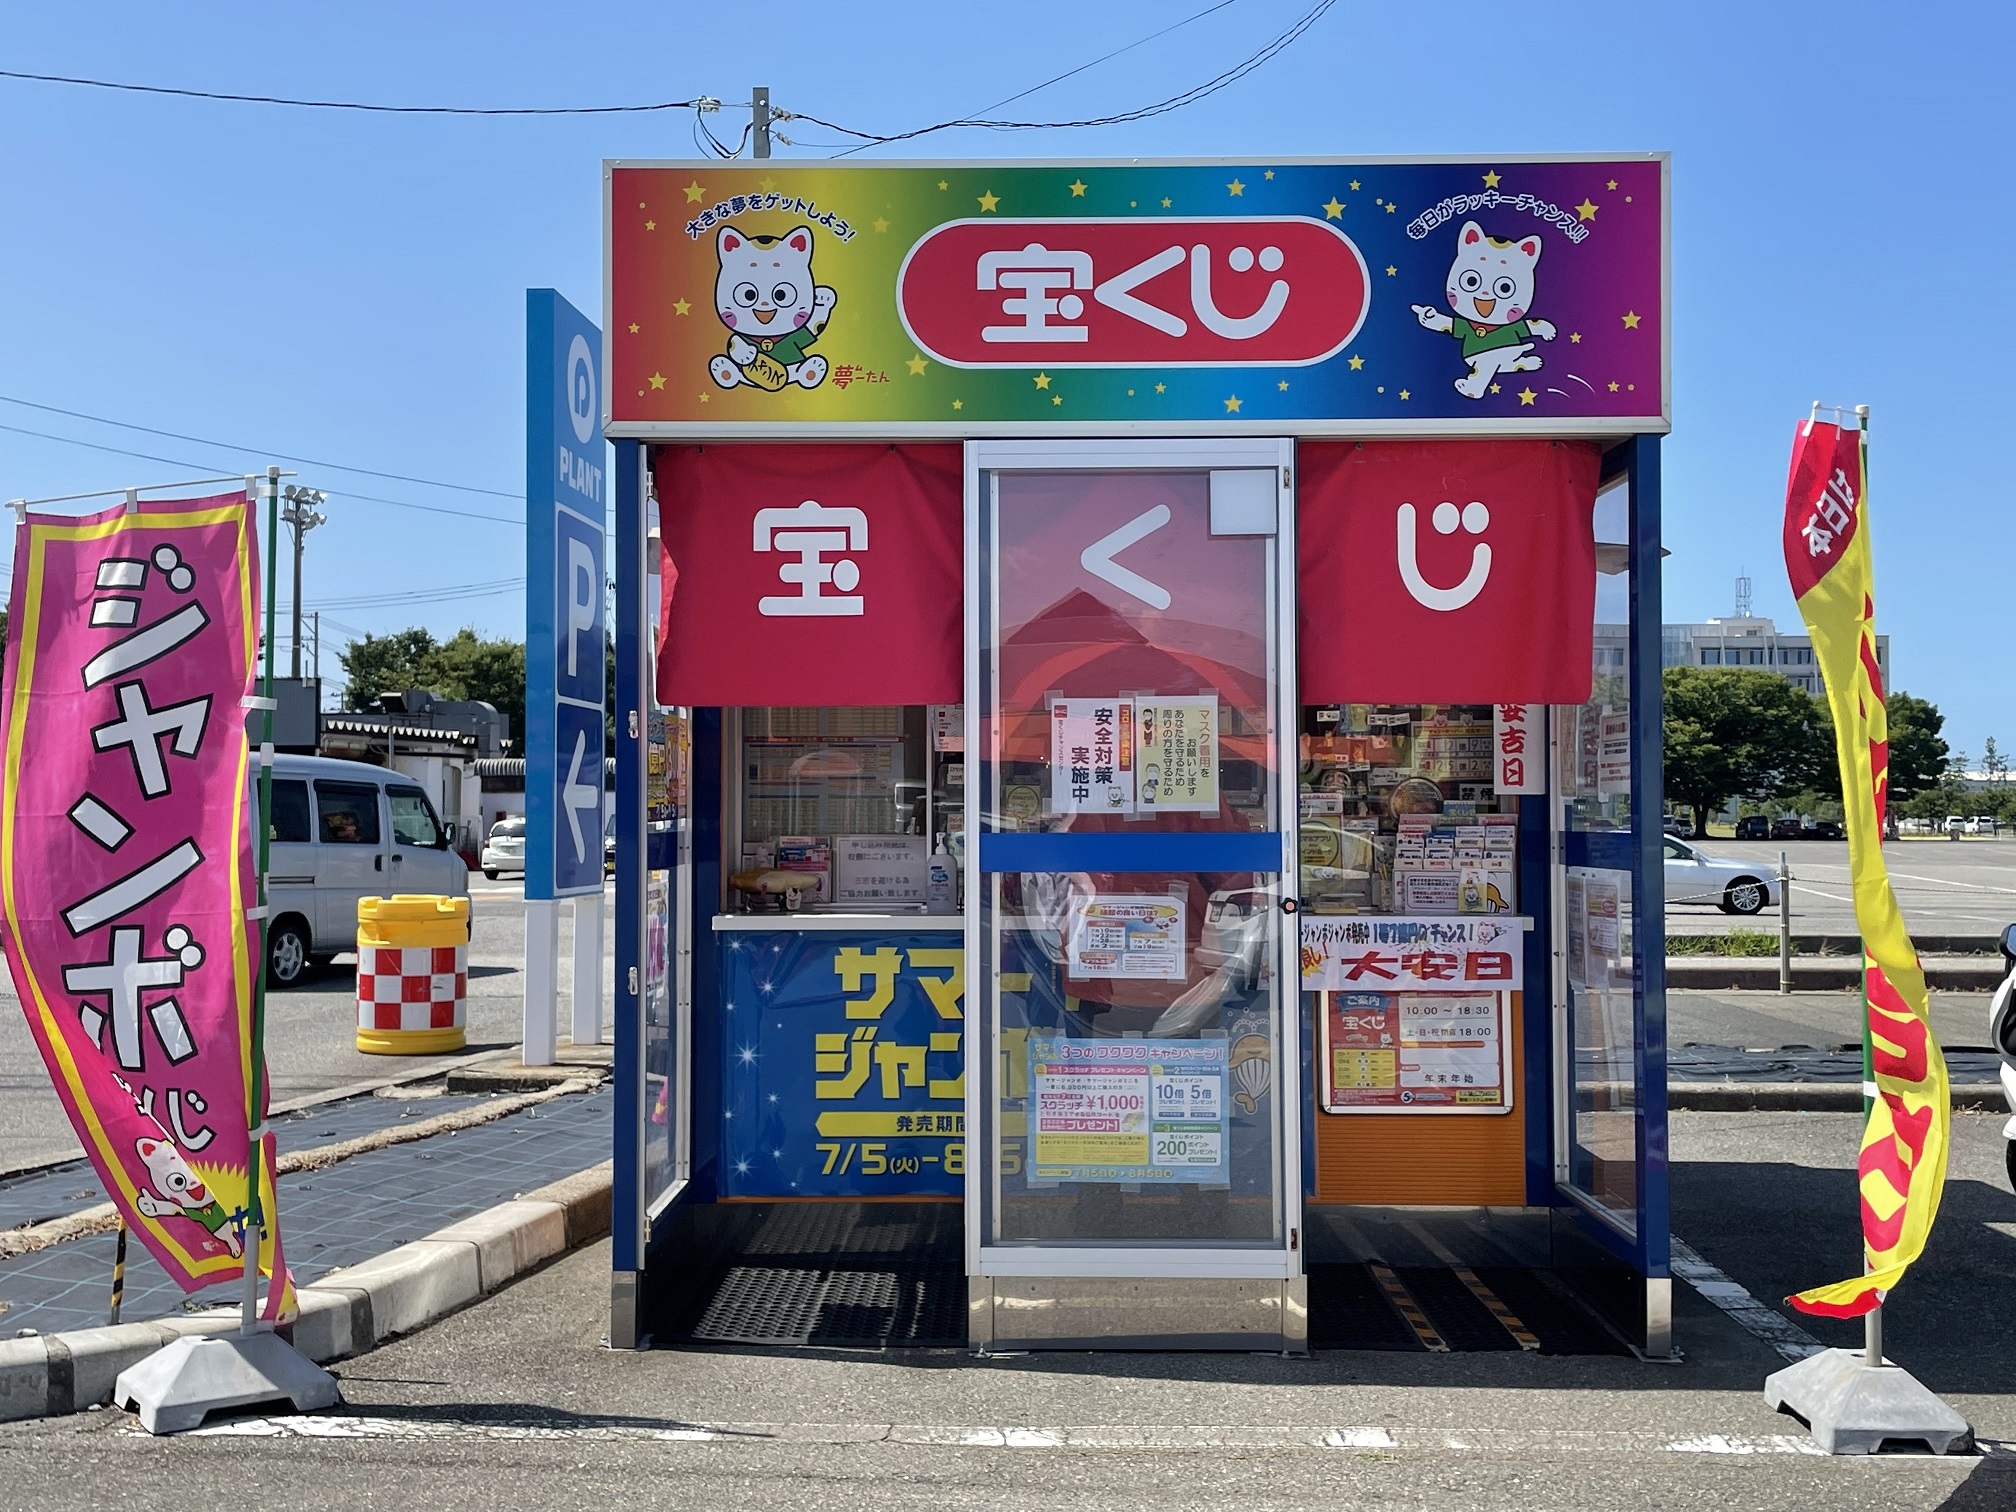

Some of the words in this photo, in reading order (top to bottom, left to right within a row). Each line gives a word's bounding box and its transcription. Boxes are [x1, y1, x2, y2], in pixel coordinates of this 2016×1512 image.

[685, 193, 857, 243] 大きな夢をゲットしよう!
[977, 243, 1290, 343] 宝くじ
[559, 445, 602, 504] PLANT
[753, 500, 868, 616] 宝
[1080, 501, 1173, 612] く
[1397, 501, 1492, 612] じ
[567, 535, 597, 678] P
[1094, 707, 1113, 785] 安全対策
[1162, 709, 1174, 797] 周りの方を守るため
[1174, 709, 1185, 787] あなたを守るため
[1186, 738, 1197, 797] お願いします
[1199, 709, 1211, 778] マスク着用を
[1071, 746, 1090, 804] 実施中
[1342, 1015, 1386, 1030] 宝くじ
[1347, 995, 1380, 1006] ご案内
[1040, 1100, 1083, 1111] スクラッチ
[1086, 1094, 1139, 1112] ¥1,000
[1155, 1084, 1185, 1100] 10倍
[1190, 1084, 1213, 1100] 5倍
[1424, 1073, 1474, 1084] 年末年始
[1066, 1120, 1119, 1131] プレゼント!
[1157, 1140, 1187, 1156] 200
